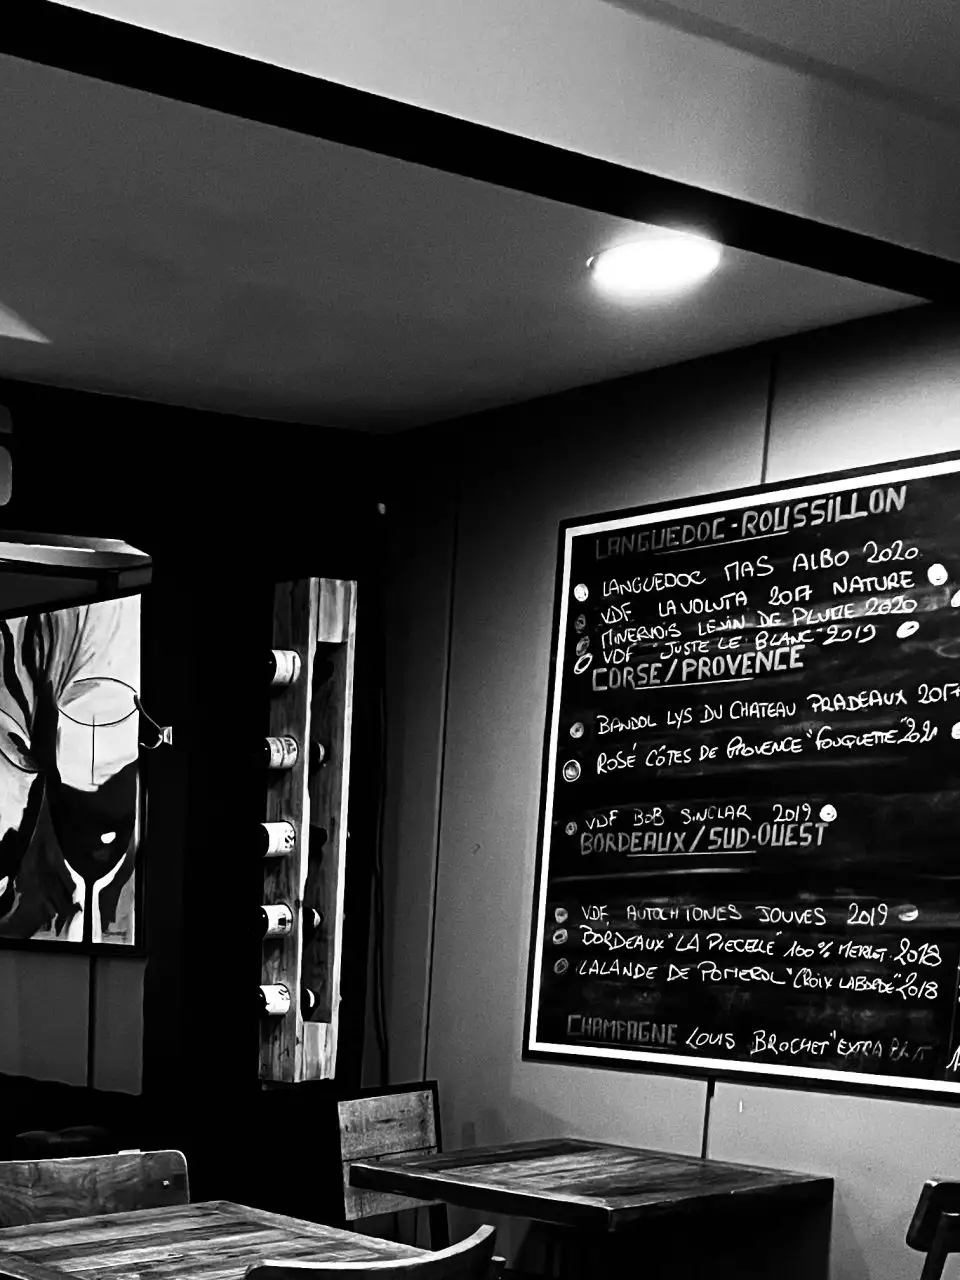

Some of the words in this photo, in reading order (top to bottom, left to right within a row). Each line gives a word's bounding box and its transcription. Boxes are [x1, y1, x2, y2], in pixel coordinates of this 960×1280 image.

[596, 485, 907, 560] LANGUEDOC-ROUSSILLON
[603, 571, 706, 597] LANGUEDOC
[724, 556, 774, 582] MAS
[793, 548, 850, 572] ALBO
[863, 540, 919, 563] 2020
[601, 602, 632, 624] VDF
[833, 571, 915, 595] NATURE
[757, 610, 782, 627] DE
[865, 595, 918, 616] 2020
[602, 642, 637, 664] VDF
[717, 635, 742, 650] LE
[822, 624, 876, 646] 2019
[596, 714, 657, 735] BANDOL
[667, 707, 693, 729] LYS
[699, 704, 723, 723] DU
[729, 701, 796, 719] CHATEAU
[806, 689, 908, 713] PRADEAUX
[596, 742, 637, 775] ROSÉ
[699, 744, 719, 761] DE
[726, 736, 803, 758] PROVENCE
[585, 809, 619, 830] VDF
[772, 803, 811, 822] 2019
[755, 906, 826, 925] JOUVES
[847, 903, 888, 926] 2019
[579, 924, 665, 951] BORDEAUX
[894, 938, 942, 967] 2018
[579, 959, 658, 979] LALANDE
[667, 964, 690, 981] DE
[697, 961, 786, 984] POMEROL
[896, 972, 938, 999] 2018
[567, 1014, 678, 1045] CHAMPAGNE
[685, 1026, 736, 1050] LOUIS
[750, 1029, 830, 1055] BROCHET
